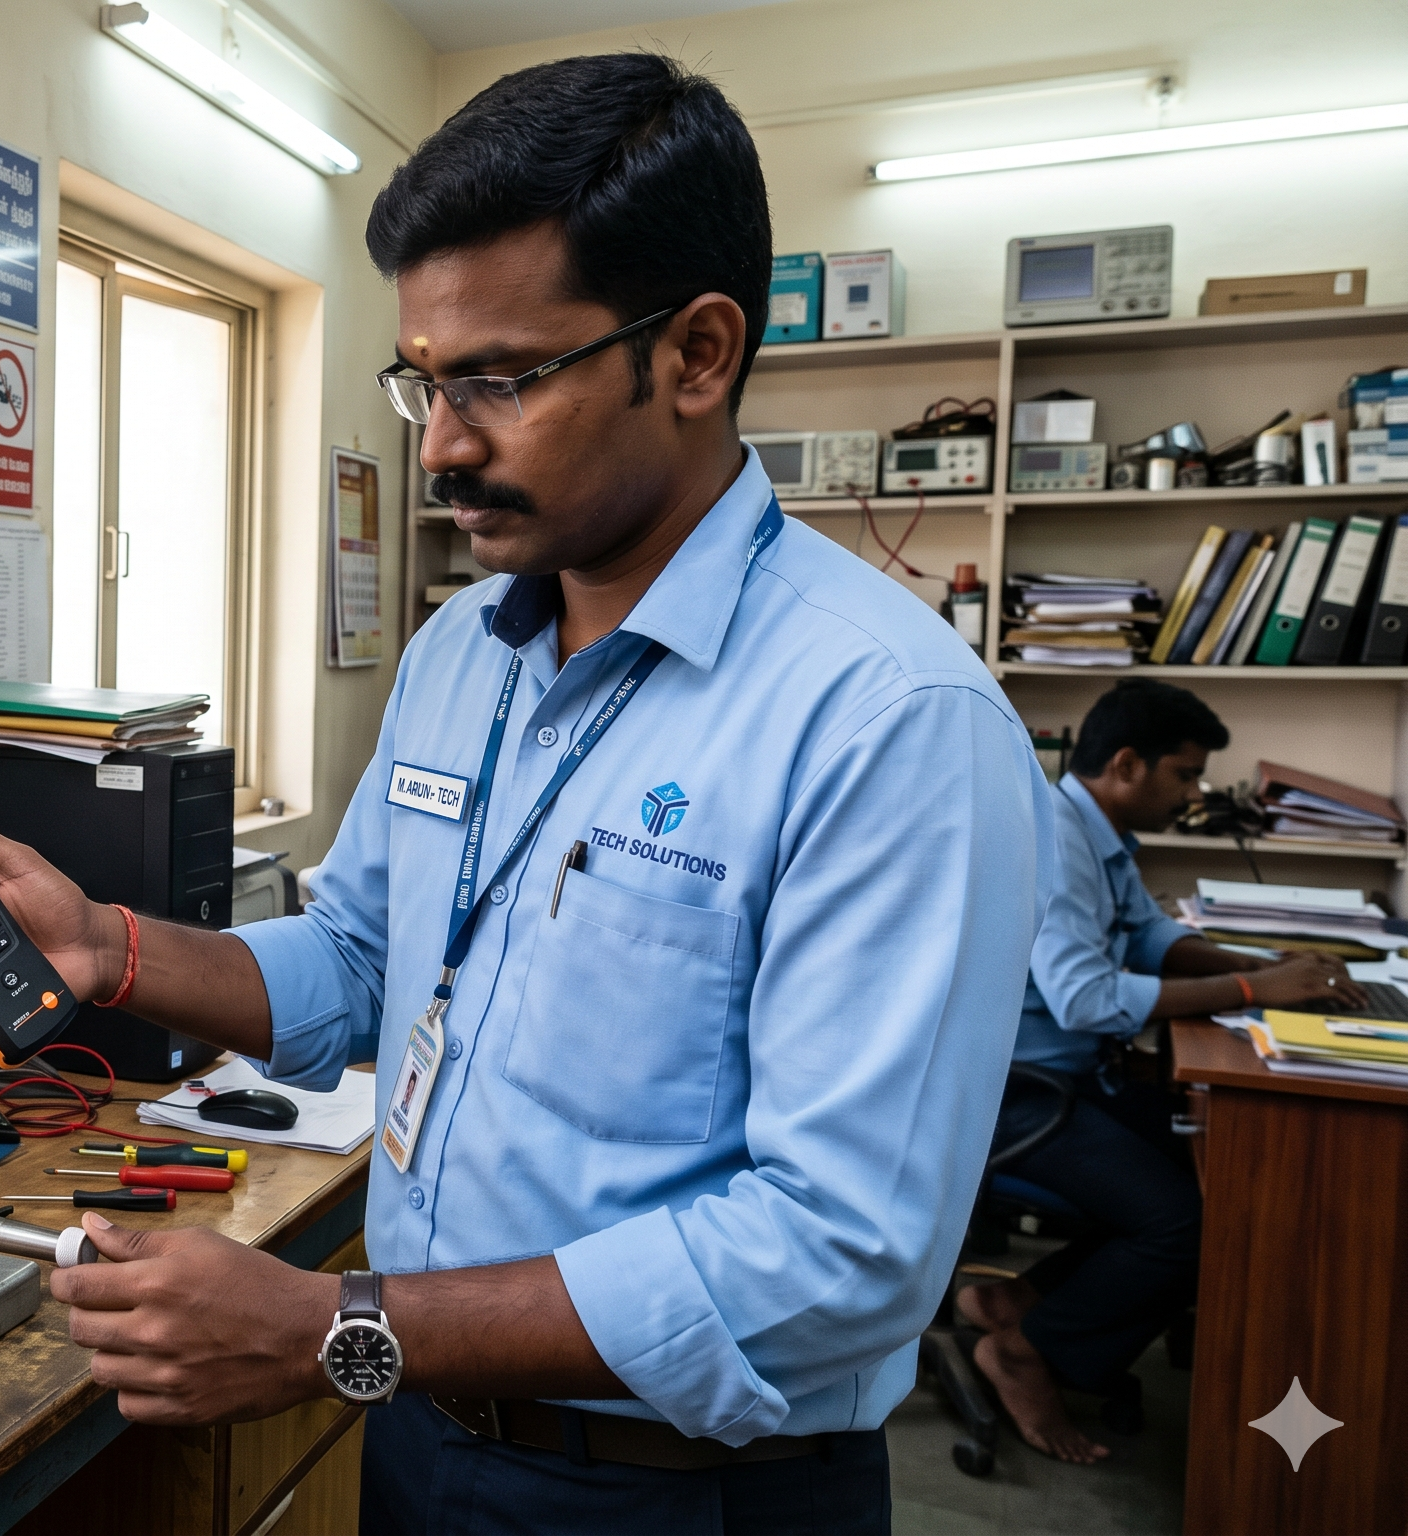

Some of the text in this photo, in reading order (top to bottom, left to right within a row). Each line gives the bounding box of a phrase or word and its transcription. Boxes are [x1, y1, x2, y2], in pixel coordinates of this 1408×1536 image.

[438, 787, 460, 807] TECH
[591, 827, 726, 881] TECH SOLUTIONS
